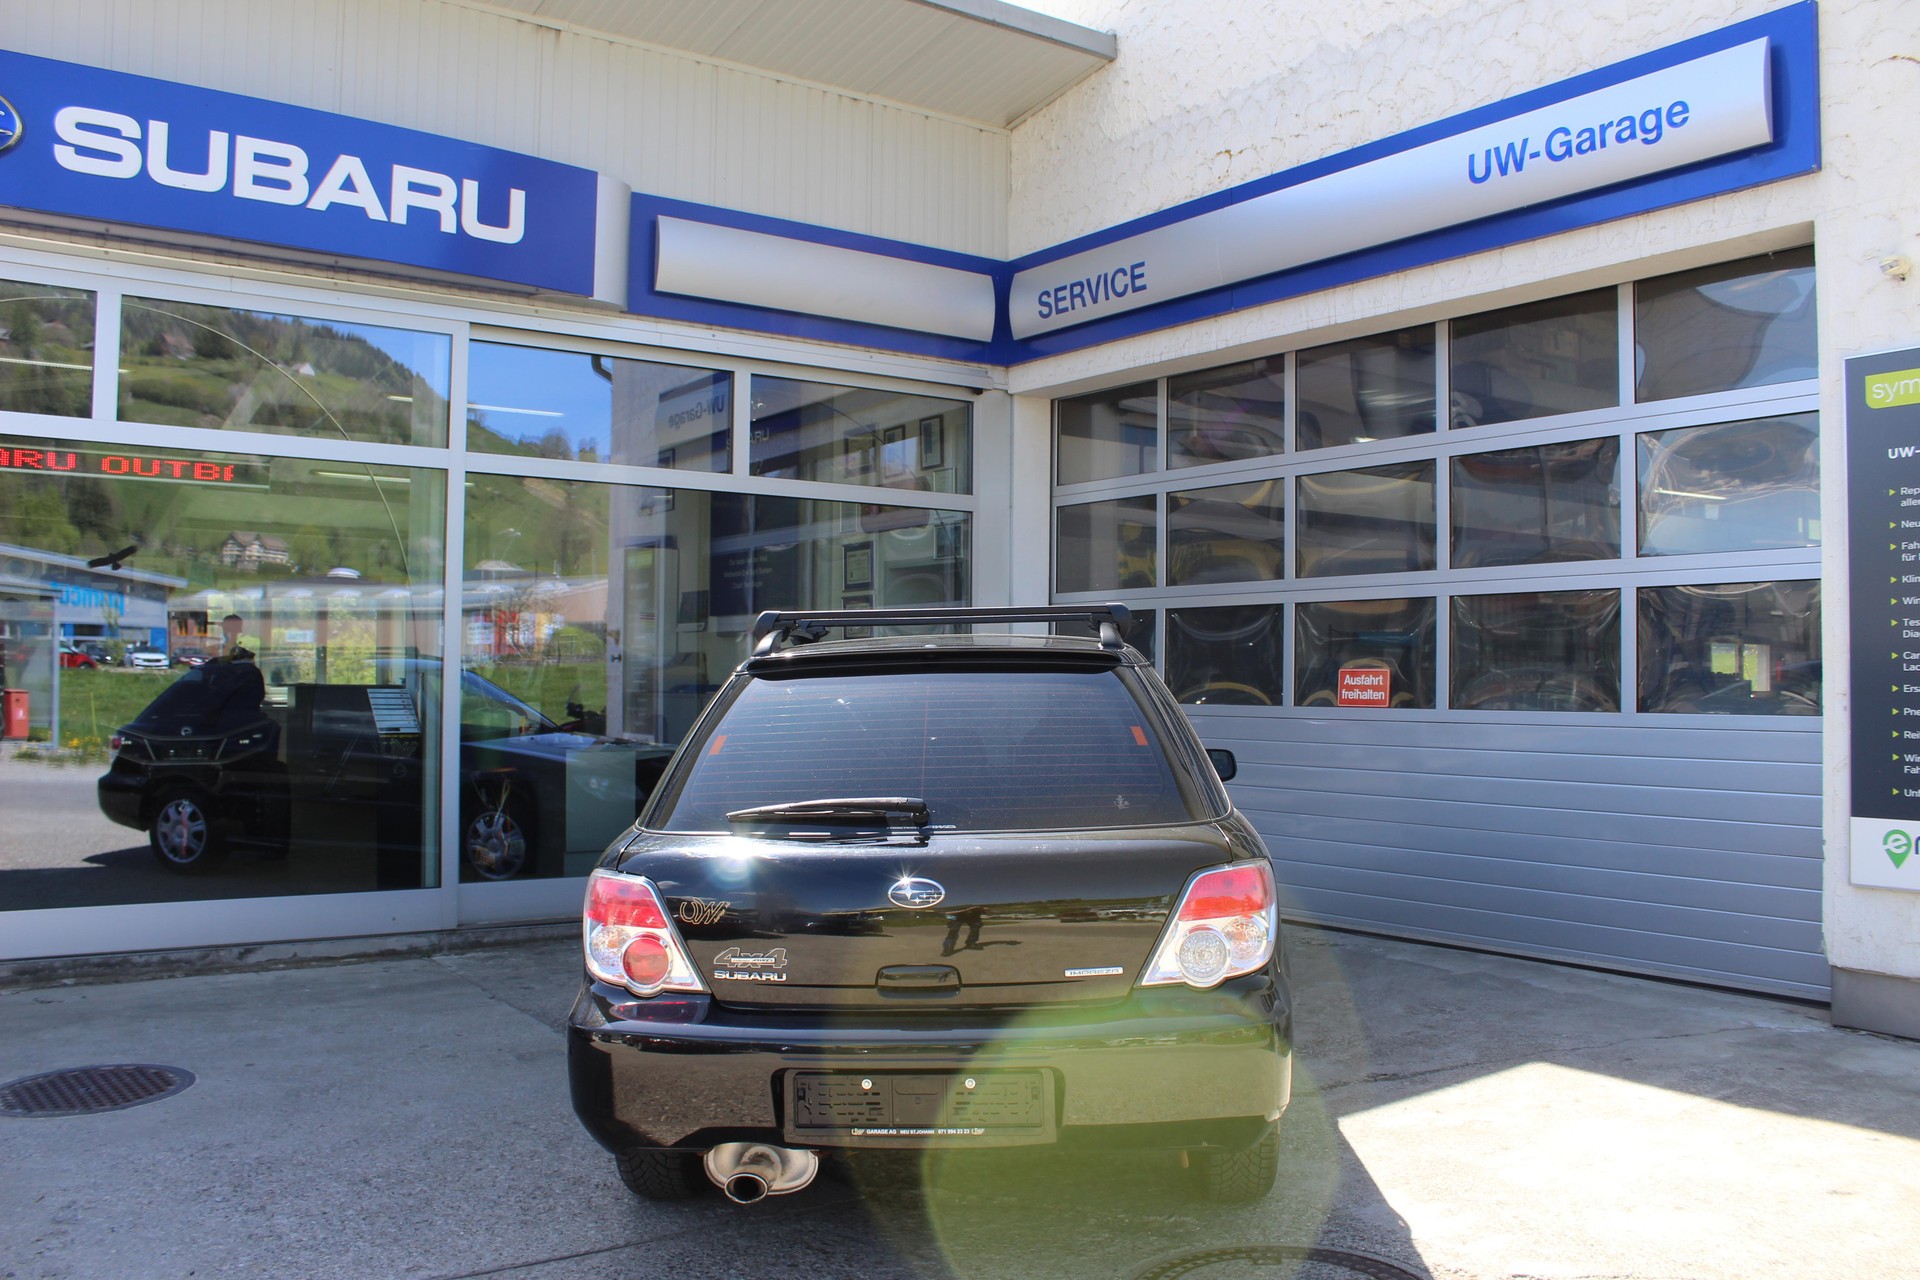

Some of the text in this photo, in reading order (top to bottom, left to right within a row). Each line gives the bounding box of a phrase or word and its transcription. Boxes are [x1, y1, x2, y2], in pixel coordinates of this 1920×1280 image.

[1467, 100, 1690, 185] UW-Garage
[53, 105, 526, 245] SUBARU
[1037, 260, 1148, 319] SERVICE
[1343, 674, 1384, 686] Ausfahrt
[1341, 688, 1385, 700] freihalten
[713, 946, 788, 969] 4x4
[713, 969, 787, 982] SUBARU
